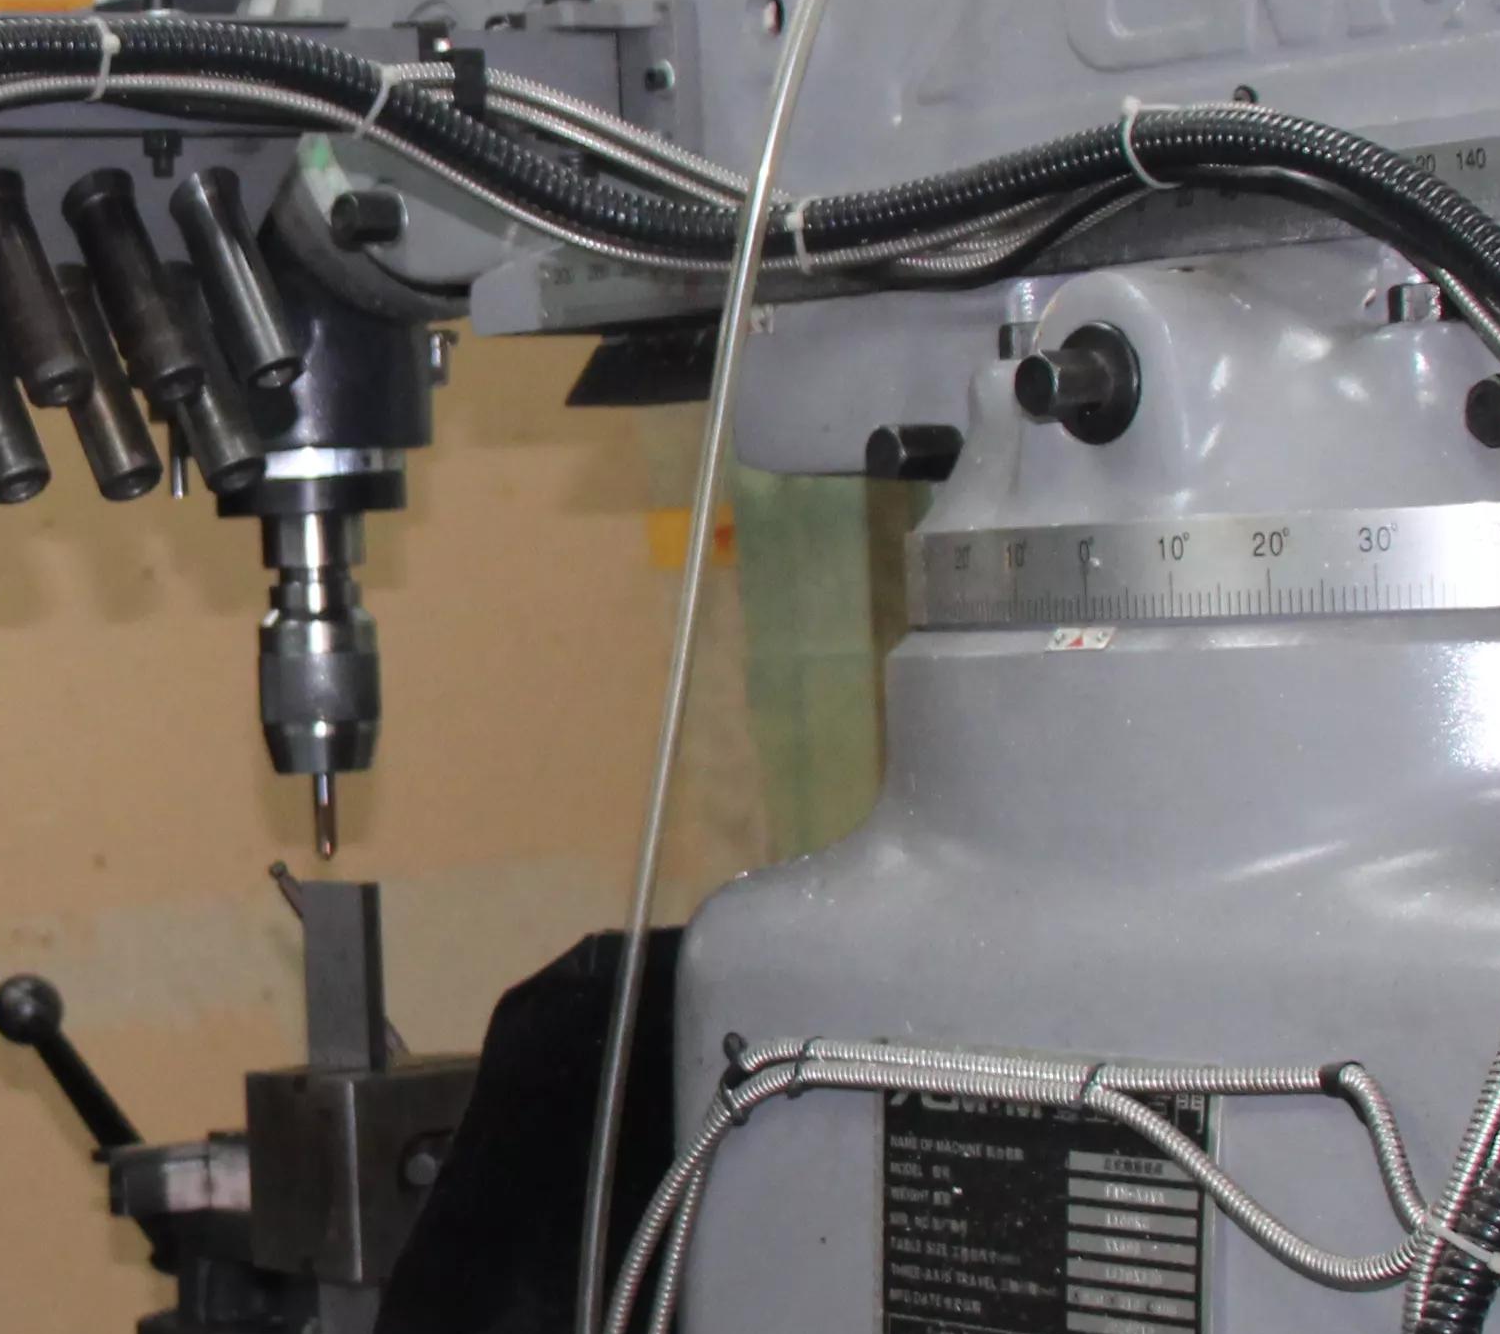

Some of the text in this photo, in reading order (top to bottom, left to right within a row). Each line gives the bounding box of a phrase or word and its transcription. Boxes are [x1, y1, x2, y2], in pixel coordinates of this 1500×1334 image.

[1456, 147, 1488, 171] 140
[1157, 531, 1191, 561] 10°
[1251, 527, 1290, 557] 20°
[1357, 522, 1398, 553] 30°
